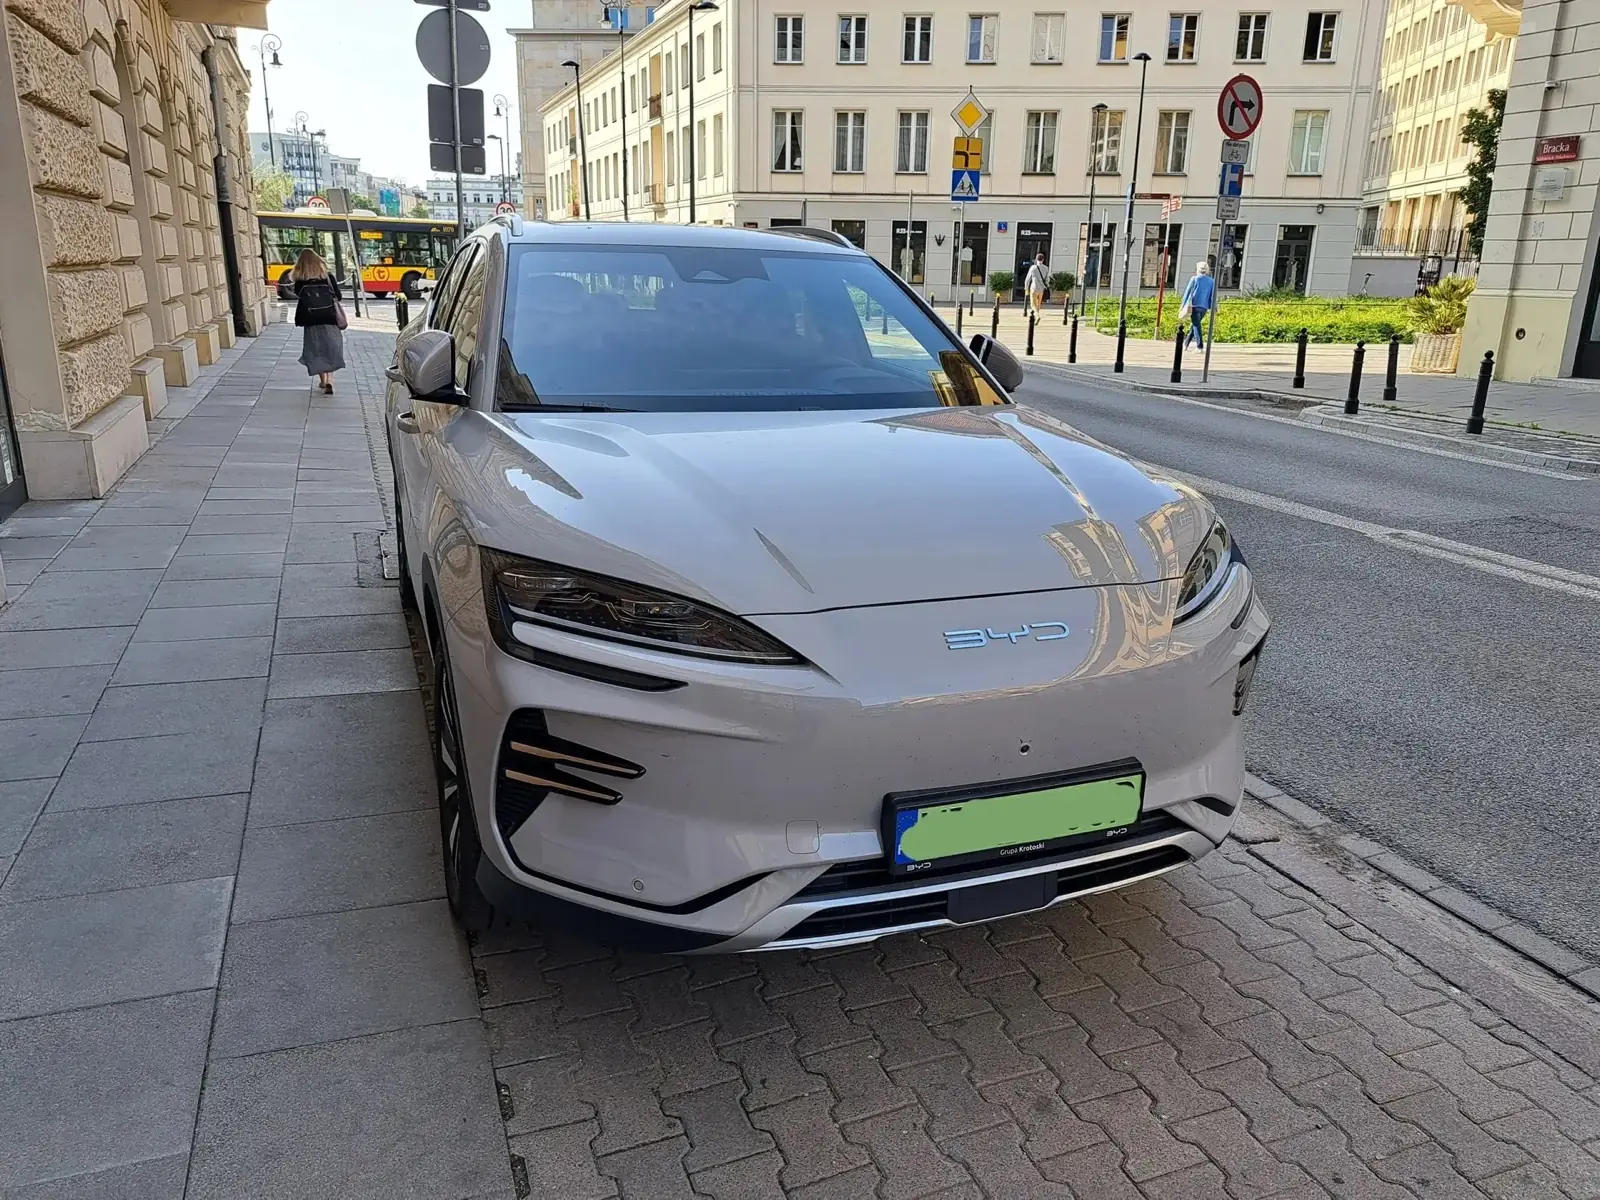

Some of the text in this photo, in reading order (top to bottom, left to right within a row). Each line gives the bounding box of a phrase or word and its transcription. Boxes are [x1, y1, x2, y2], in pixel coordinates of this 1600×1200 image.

[1543, 142, 1570, 154] Bracka
[943, 621, 1070, 650] BYD
[1106, 827, 1128, 837] BYD
[1000, 842, 1045, 855] Grupa Krotoski
[906, 861, 932, 871] BYD
